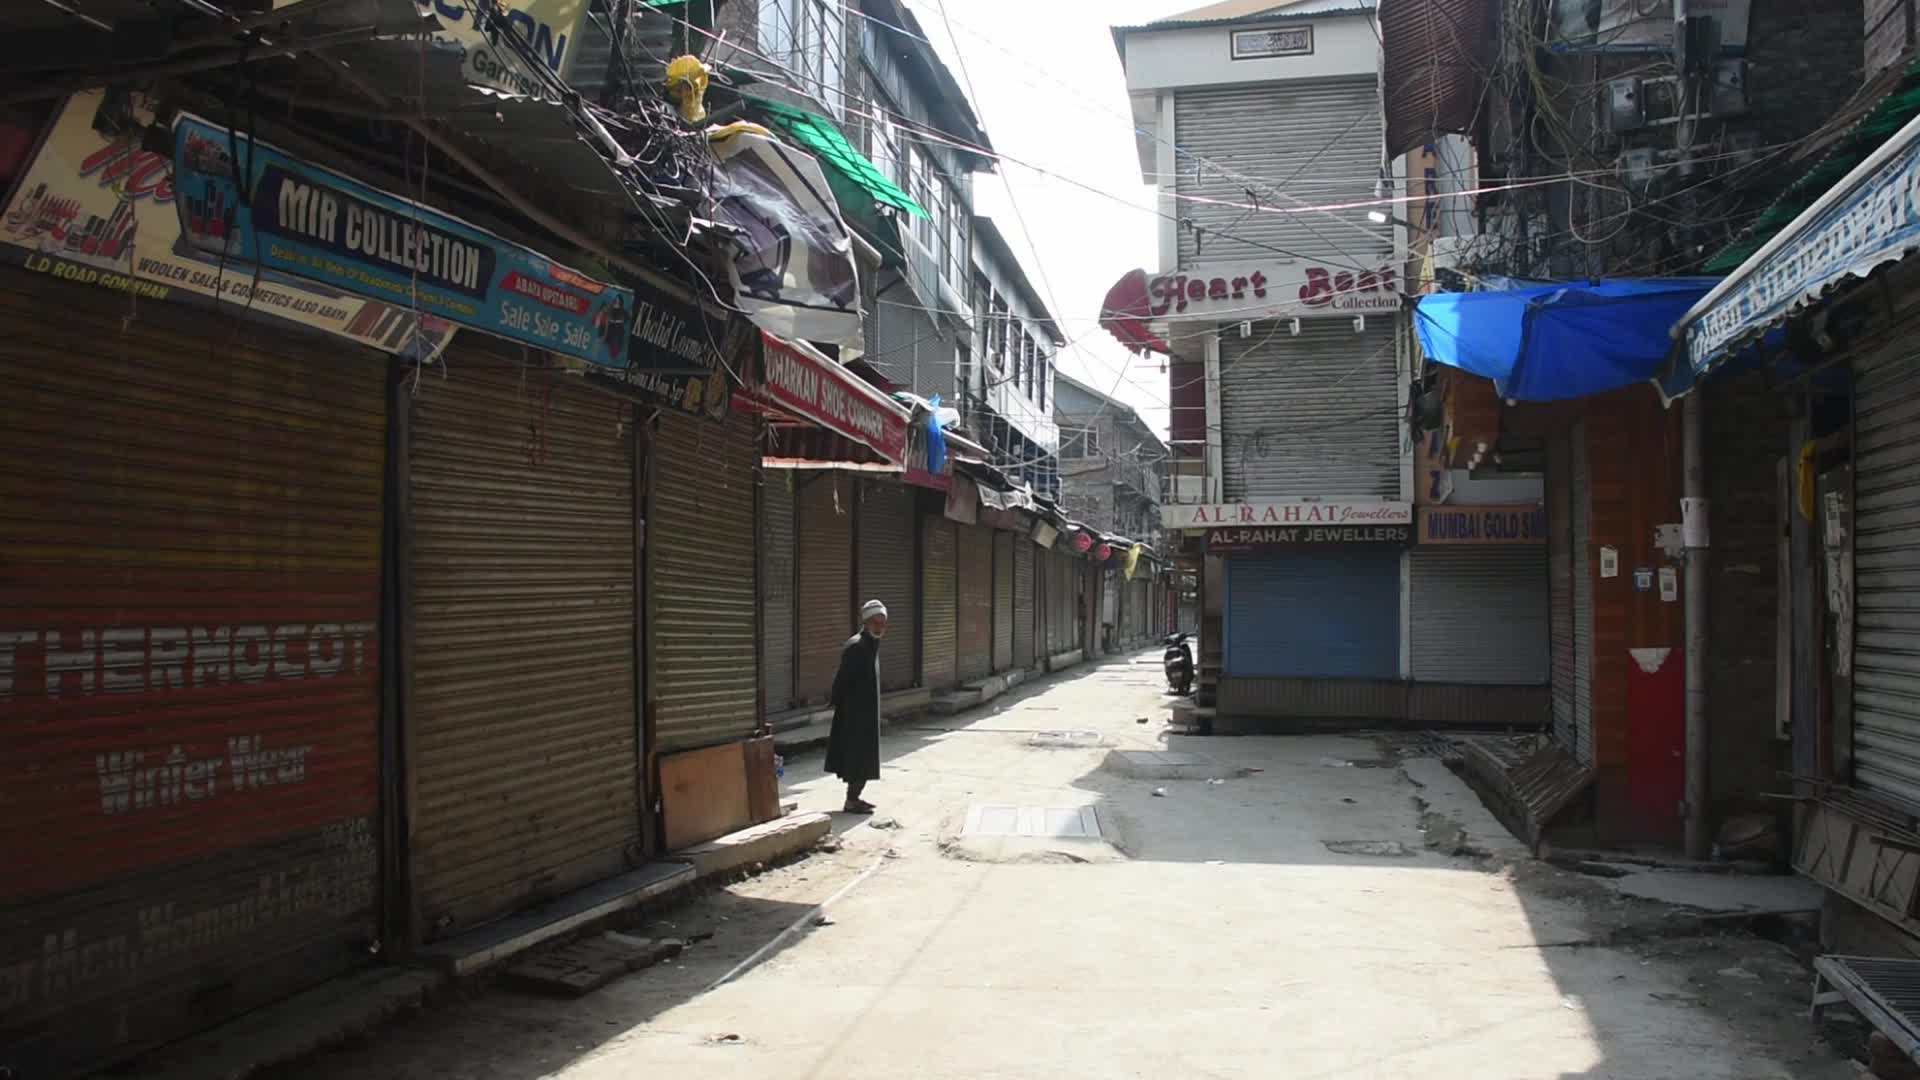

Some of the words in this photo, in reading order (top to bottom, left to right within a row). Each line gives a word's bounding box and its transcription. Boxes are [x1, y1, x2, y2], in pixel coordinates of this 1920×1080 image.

[278, 177, 338, 243] MIR
[345, 202, 480, 290] COLLECTION
[52, 260, 98, 284] ROAD
[138, 256, 188, 281] WOOLEN
[189, 270, 219, 290] SALE
[231, 282, 290, 308] COSMETICS
[290, 298, 318, 314] ALSO
[317, 303, 349, 322] ABAYA
[1150, 270, 1267, 316] Heart
[1330, 296, 1398, 309] Collection
[500, 301, 529, 331] Sale
[533, 311, 560, 337] Sale
[563, 321, 592, 350] Sale
[821, 377, 847, 422] SHOE
[1192, 505, 1339, 523] AL-RAHAT
[1339, 505, 1409, 523] Jewellers
[1210, 529, 1298, 544] AL-RAHAT
[1303, 527, 1409, 542] JEWELLERS
[1428, 512, 1481, 539] MUMBAI
[1484, 512, 1519, 539] GOLD
[0, 624, 376, 701] THERMOCOT
[96, 744, 226, 815] Winter
